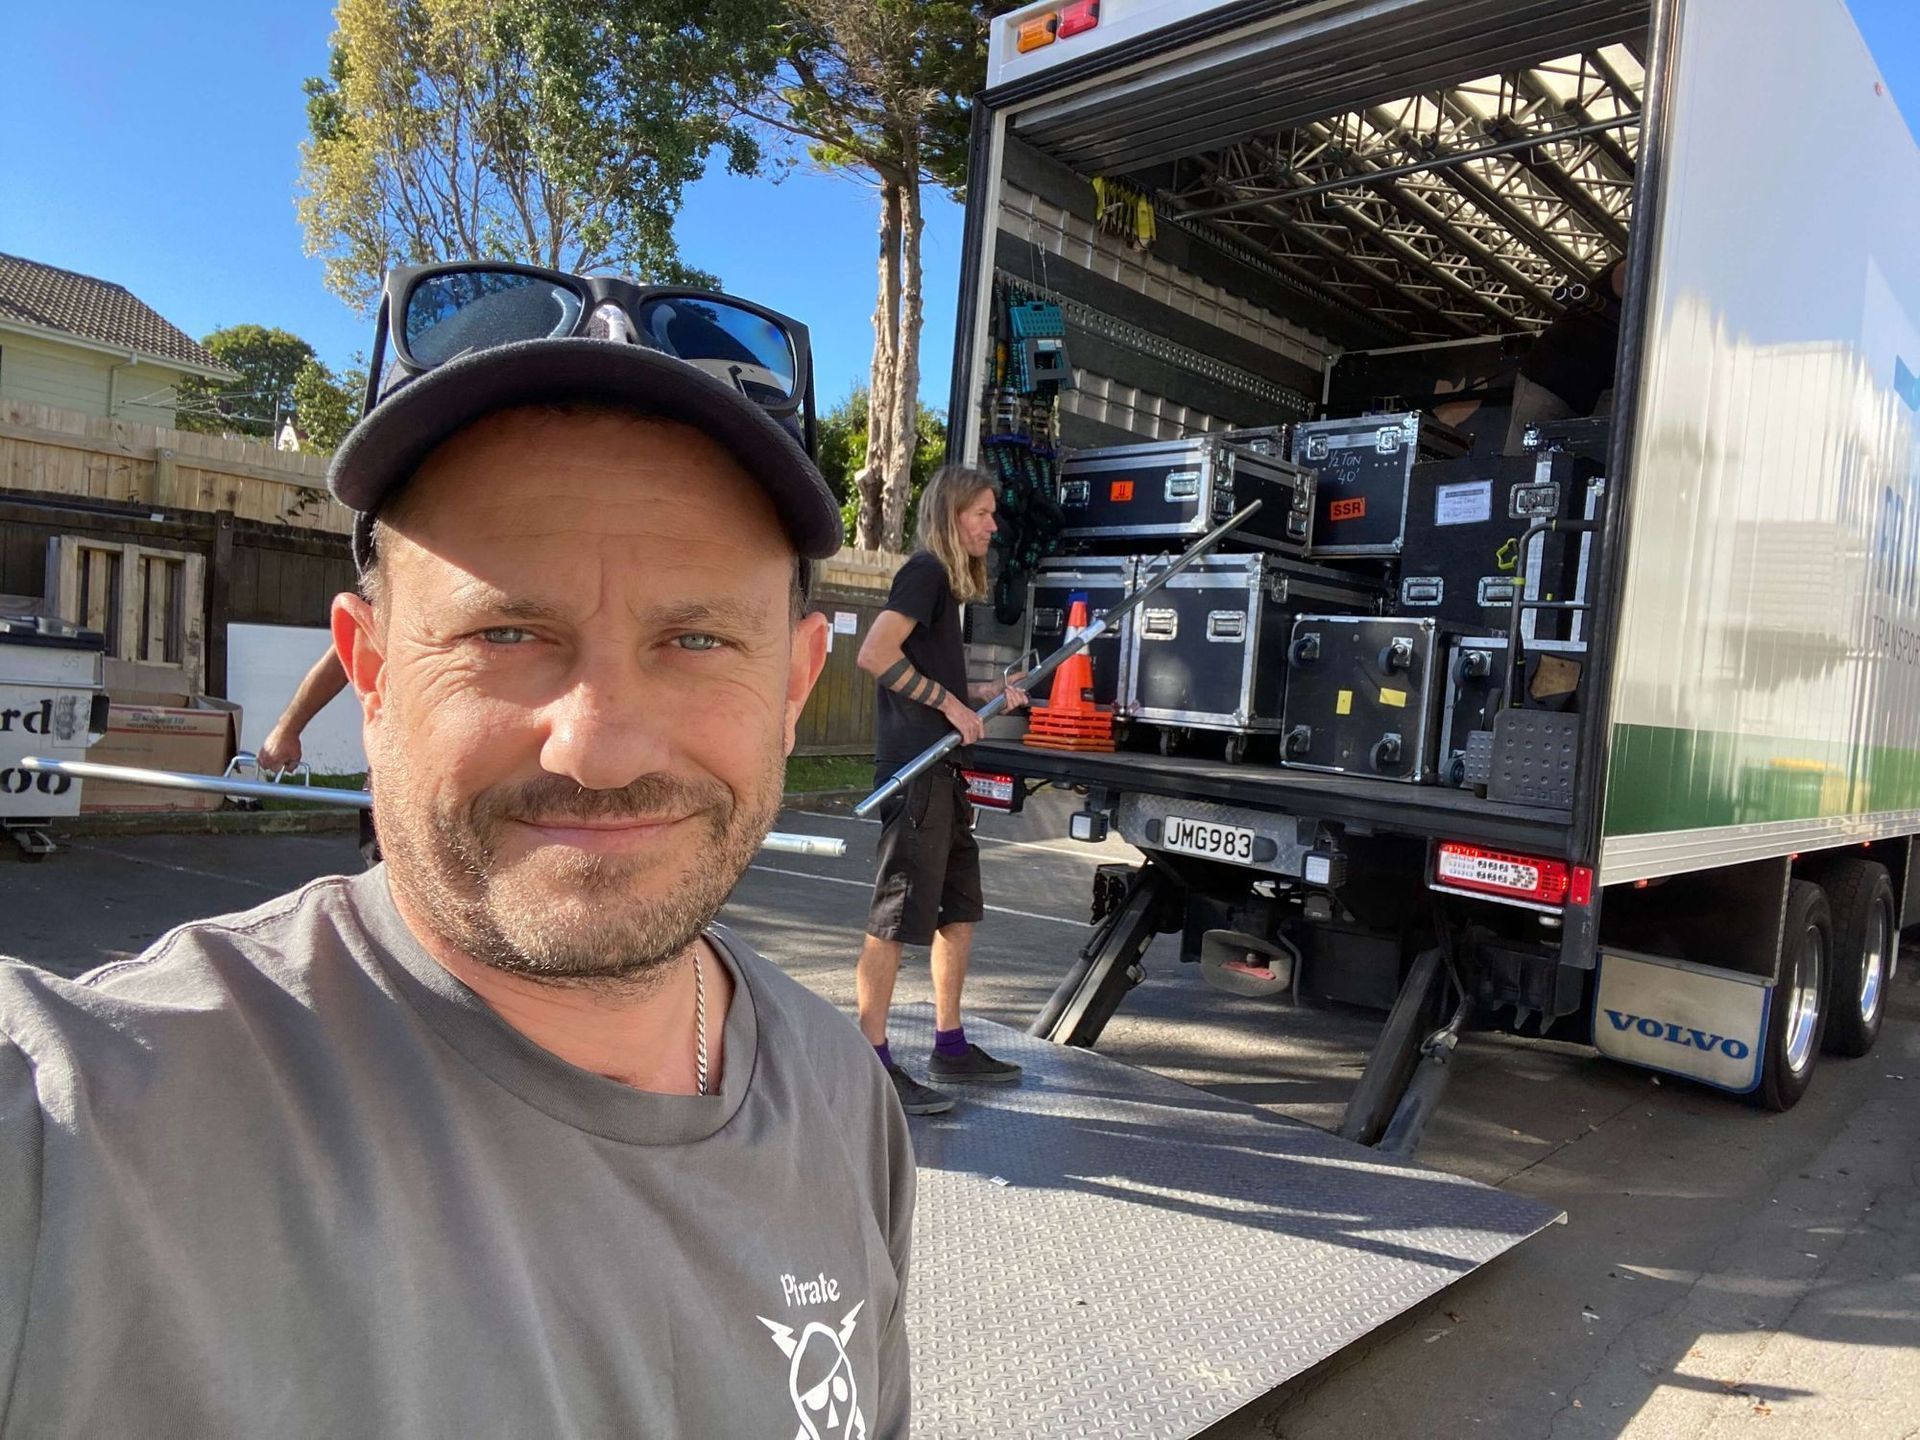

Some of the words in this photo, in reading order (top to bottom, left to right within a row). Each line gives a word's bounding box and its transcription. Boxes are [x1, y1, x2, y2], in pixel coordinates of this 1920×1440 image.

[1341, 451, 1362, 466] TON
[1333, 501, 1362, 517] SSR
[1168, 822, 1251, 859] JMG983
[1604, 1009, 1750, 1060] VOLVO
[780, 1272, 841, 1307] Pirate
